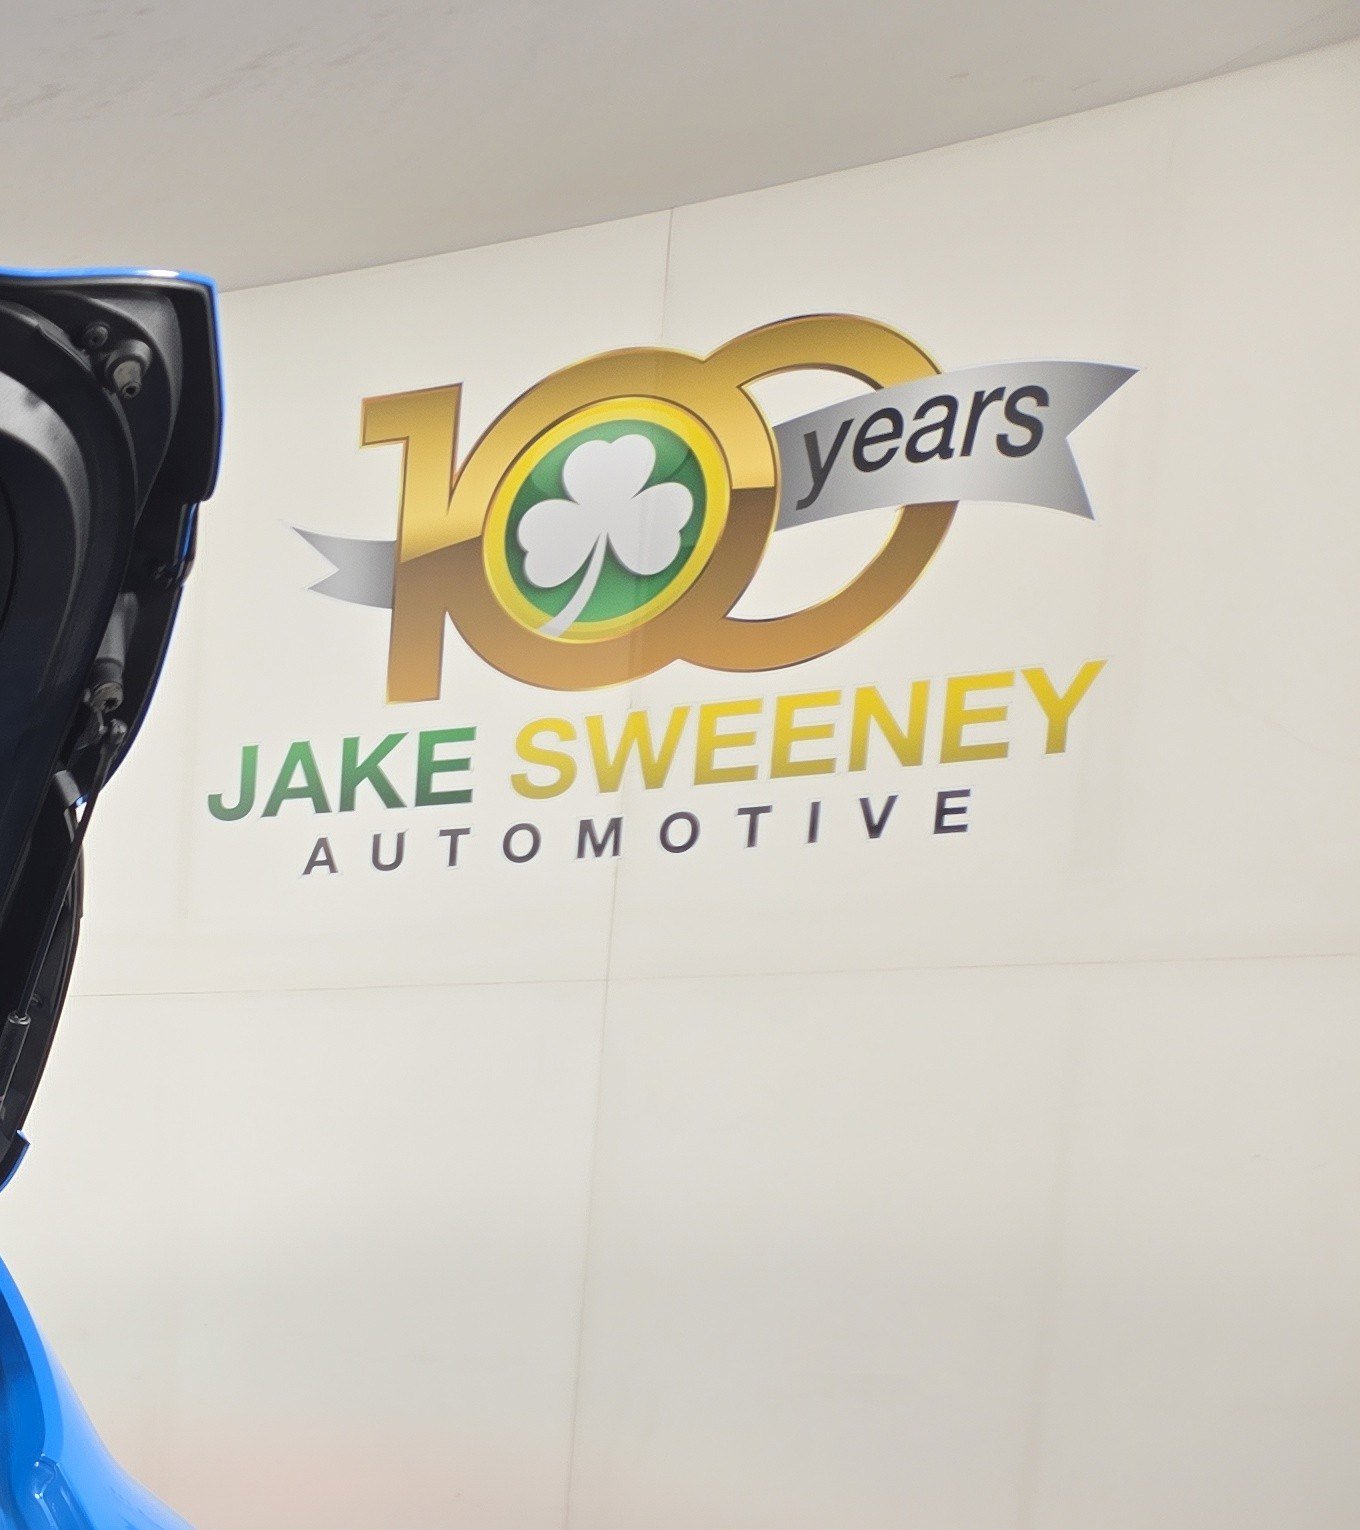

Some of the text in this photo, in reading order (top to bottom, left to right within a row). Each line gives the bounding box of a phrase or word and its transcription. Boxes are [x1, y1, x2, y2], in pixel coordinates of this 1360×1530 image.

[794, 384, 1050, 512] years
[207, 660, 1107, 822] JAKE SWEENEY
[302, 788, 971, 877] AUTOMOTIVE
